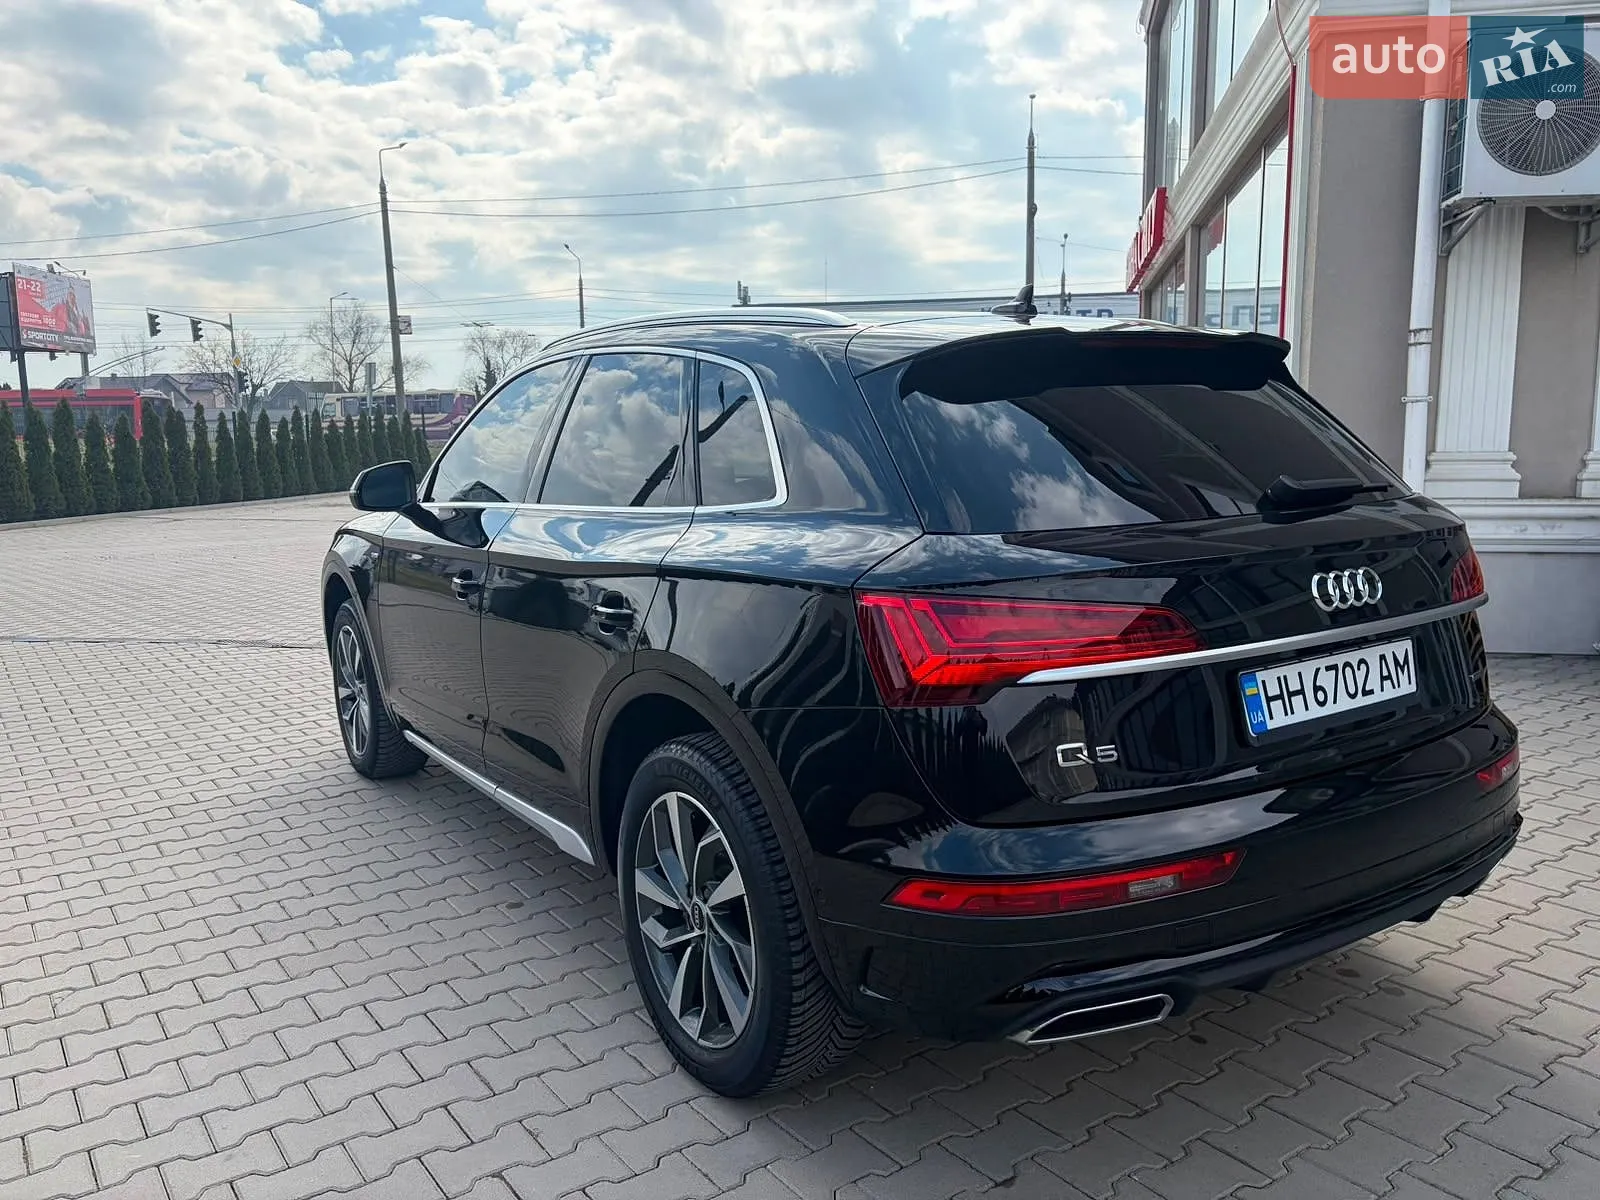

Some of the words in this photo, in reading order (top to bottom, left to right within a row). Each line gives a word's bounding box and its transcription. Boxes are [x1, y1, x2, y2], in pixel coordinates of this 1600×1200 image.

[17, 278, 41, 292] 21-22
[1261, 671, 1310, 720] HH
[1312, 657, 1375, 708] 6702
[1378, 647, 1412, 693] AM
[1250, 711, 1265, 724] UA
[1056, 742, 1118, 767] Q5
